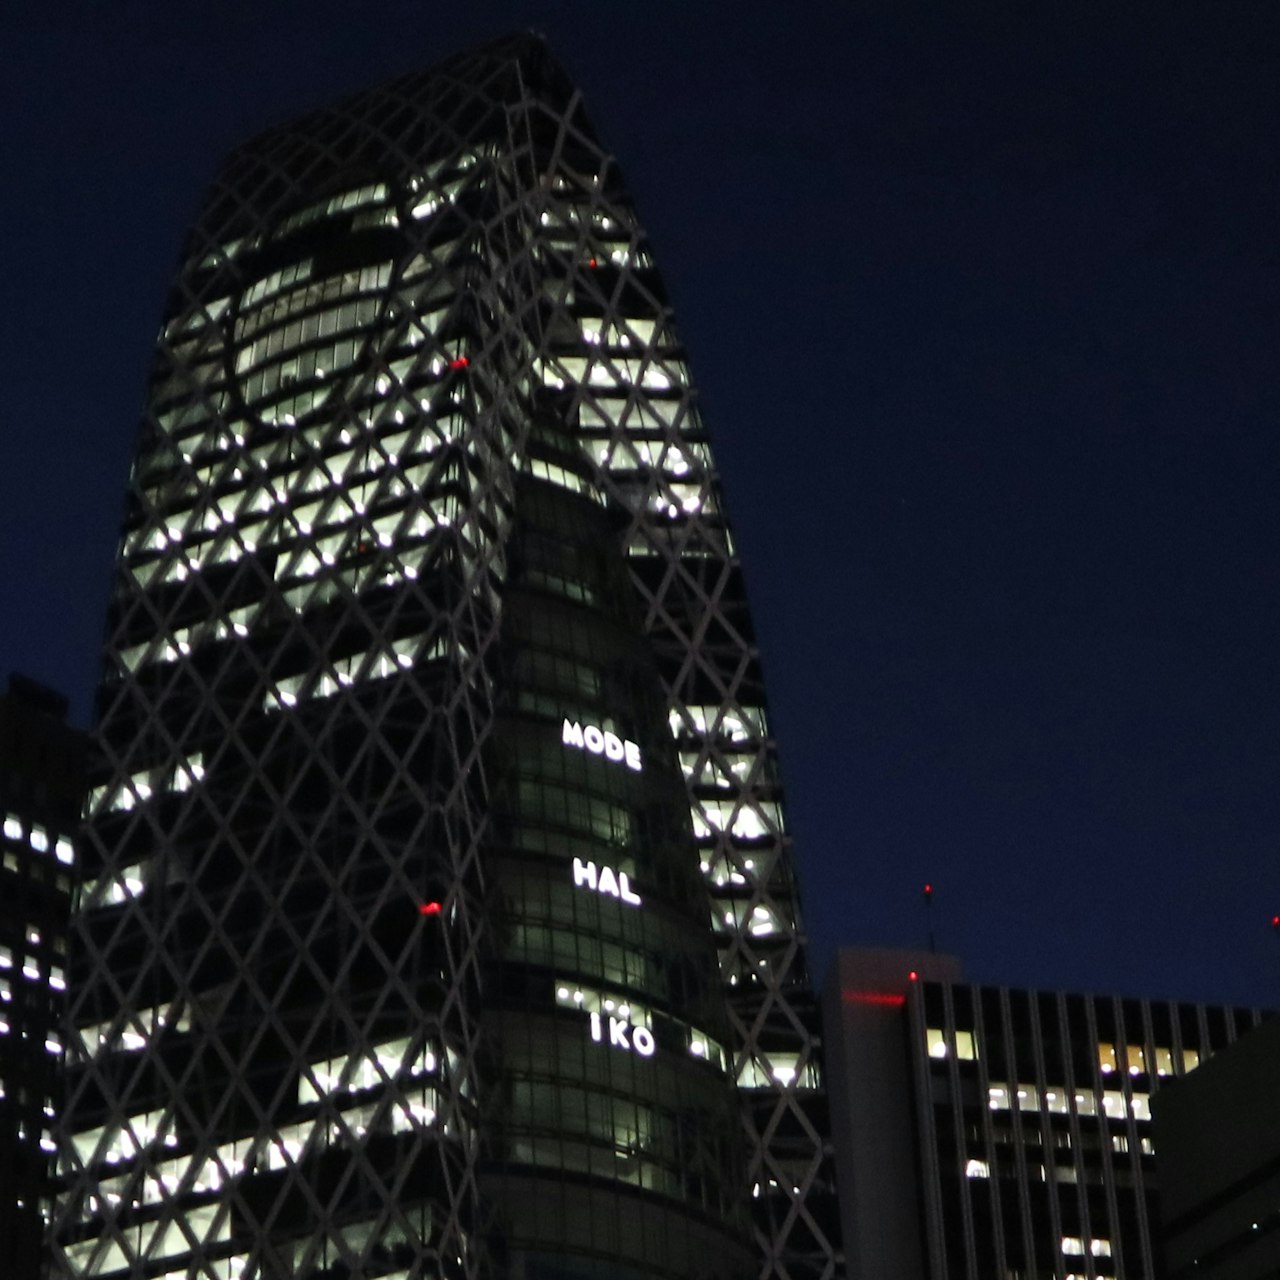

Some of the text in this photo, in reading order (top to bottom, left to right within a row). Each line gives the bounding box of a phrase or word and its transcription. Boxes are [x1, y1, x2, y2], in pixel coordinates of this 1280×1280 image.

[562, 717, 643, 772] MODE
[572, 856, 643, 906] HAL
[589, 1010, 656, 1057] IKO
